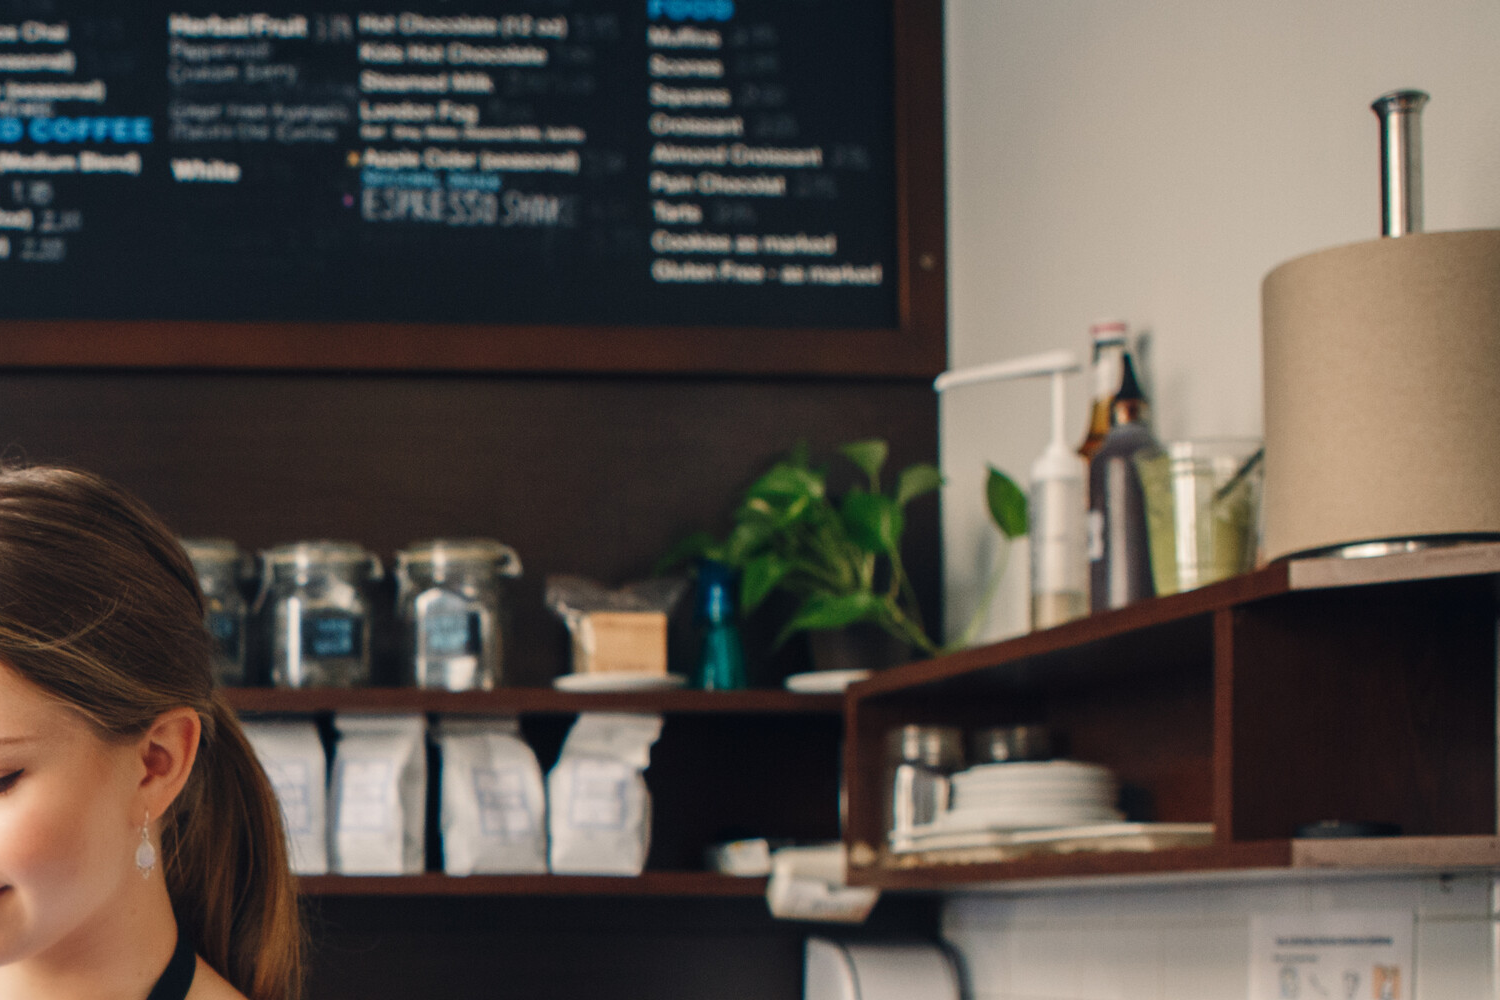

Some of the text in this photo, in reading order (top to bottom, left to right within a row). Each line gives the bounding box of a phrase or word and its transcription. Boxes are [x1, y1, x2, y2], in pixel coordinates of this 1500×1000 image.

[19, 22, 69, 43] Chai
[169, 14, 307, 38] Herbal/Fruit
[358, 16, 397, 33] Hot
[399, 14, 498, 36] Chocolate
[647, 28, 720, 47] Muffins
[358, 44, 547, 65] Kids Hot Chocolate
[649, 56, 723, 77] Scones
[360, 71, 450, 93] Steamed
[451, 74, 493, 92] Milk
[650, 85, 730, 107] Squares
[359, 101, 479, 128] London Fog
[650, 115, 743, 136] Croissant
[28, 116, 151, 143] COFFEE
[362, 149, 422, 170] Apple
[423, 149, 477, 170] Cider
[652, 145, 728, 164] Almond
[728, 145, 822, 167] Croissant
[172, 160, 239, 182] White
[649, 172, 696, 194] Pain
[697, 174, 785, 196] Chocolat
[654, 201, 701, 223] Tarts
[651, 231, 836, 254] Cookies as marked
[651, 261, 718, 281] Gluten
[719, 262, 765, 282] Free
[781, 267, 806, 283] as
[808, 266, 882, 284] marked
